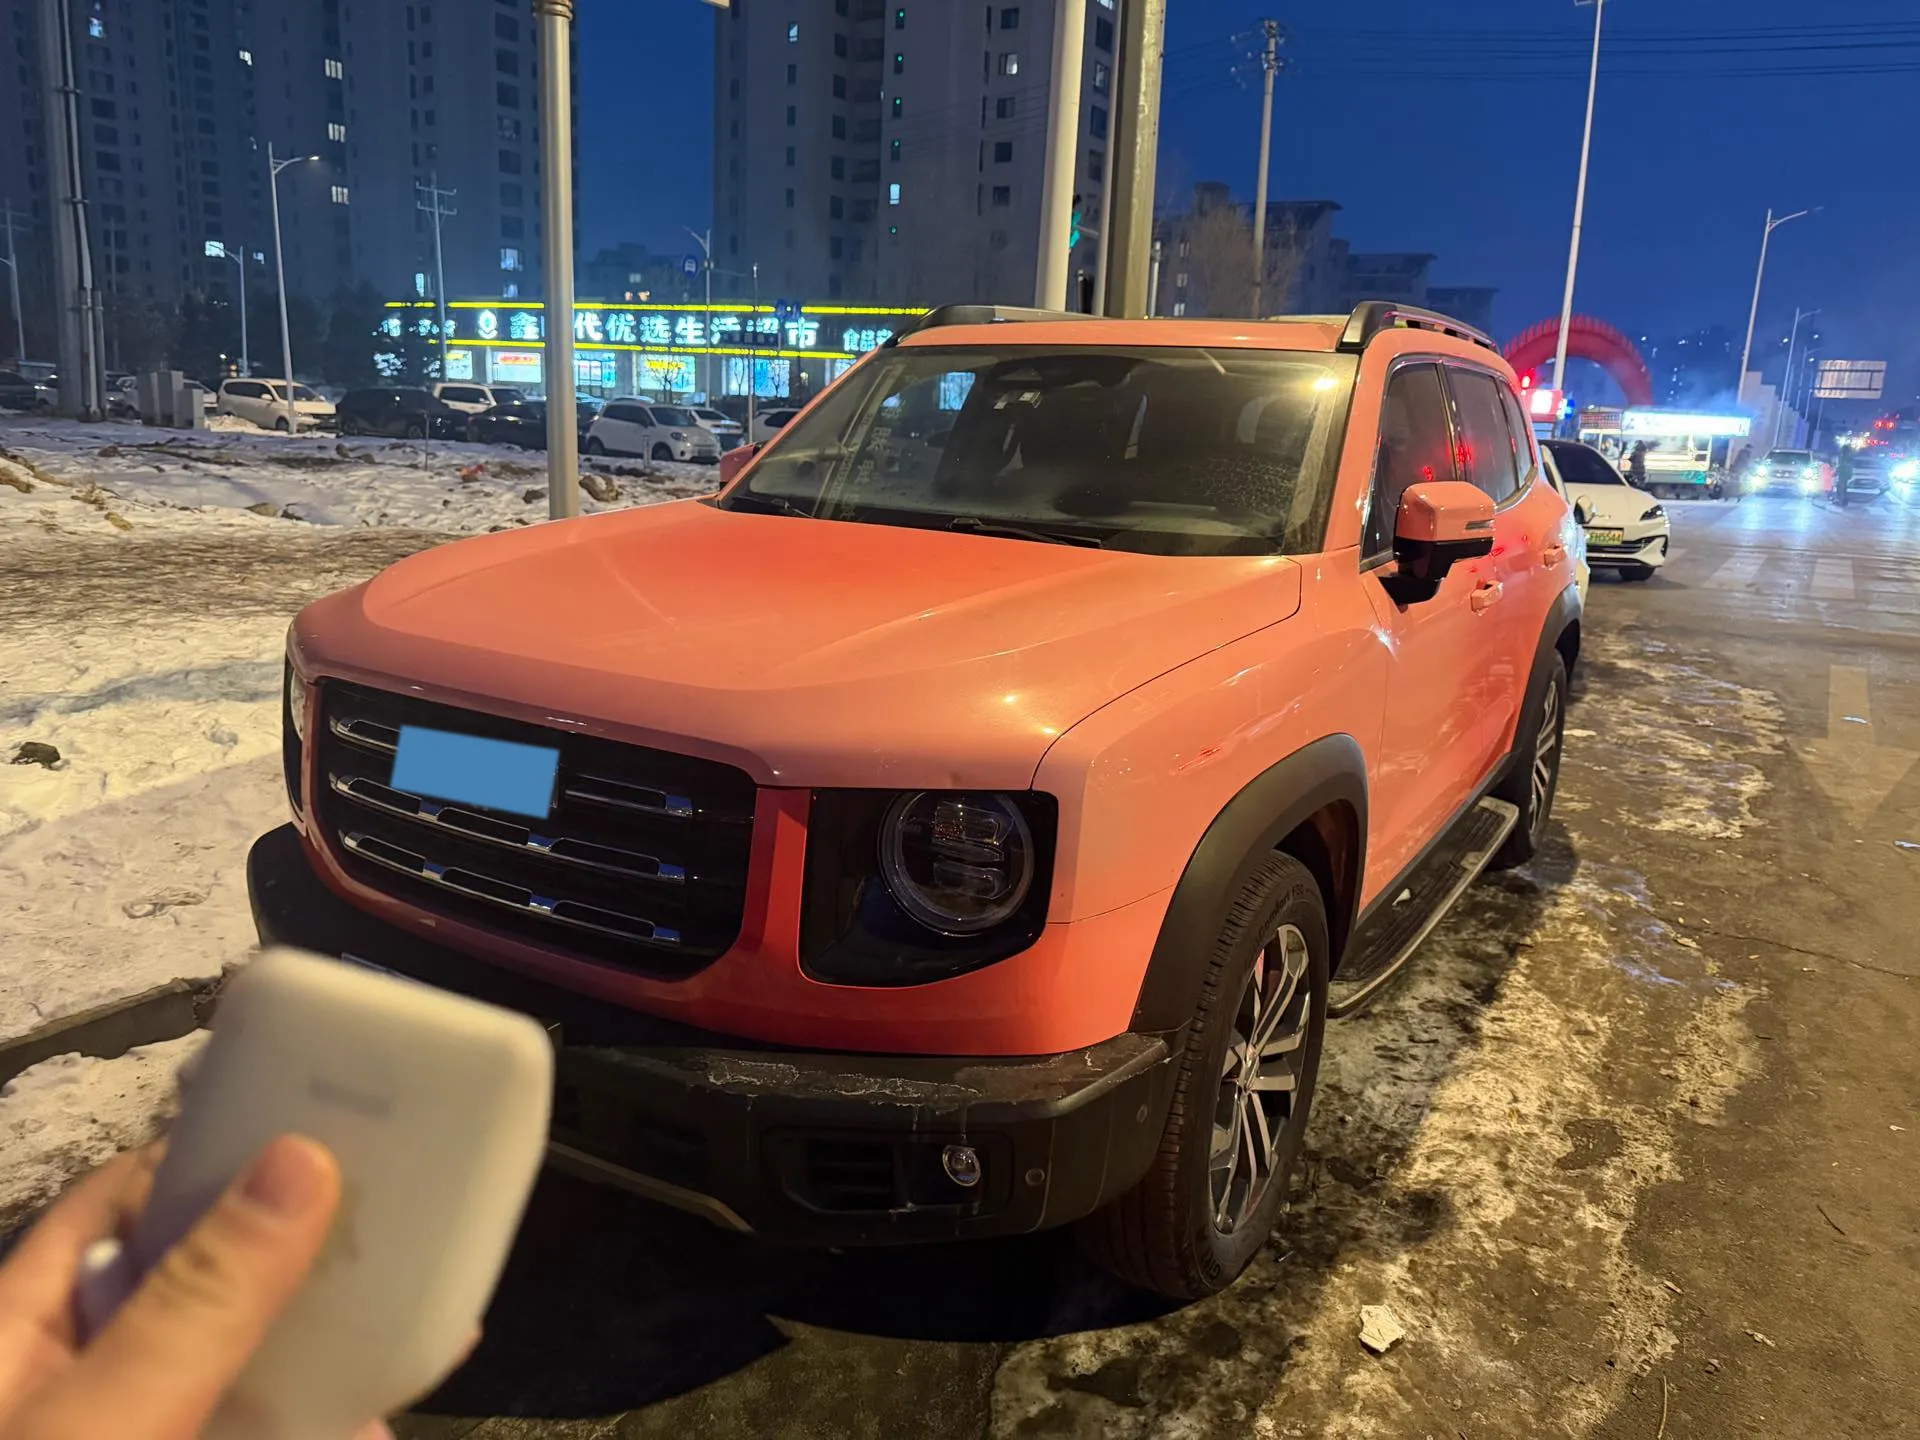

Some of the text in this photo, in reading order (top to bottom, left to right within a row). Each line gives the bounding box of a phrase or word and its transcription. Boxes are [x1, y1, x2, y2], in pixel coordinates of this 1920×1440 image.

[510, 310, 820, 349] 鑫代优选生活超市
